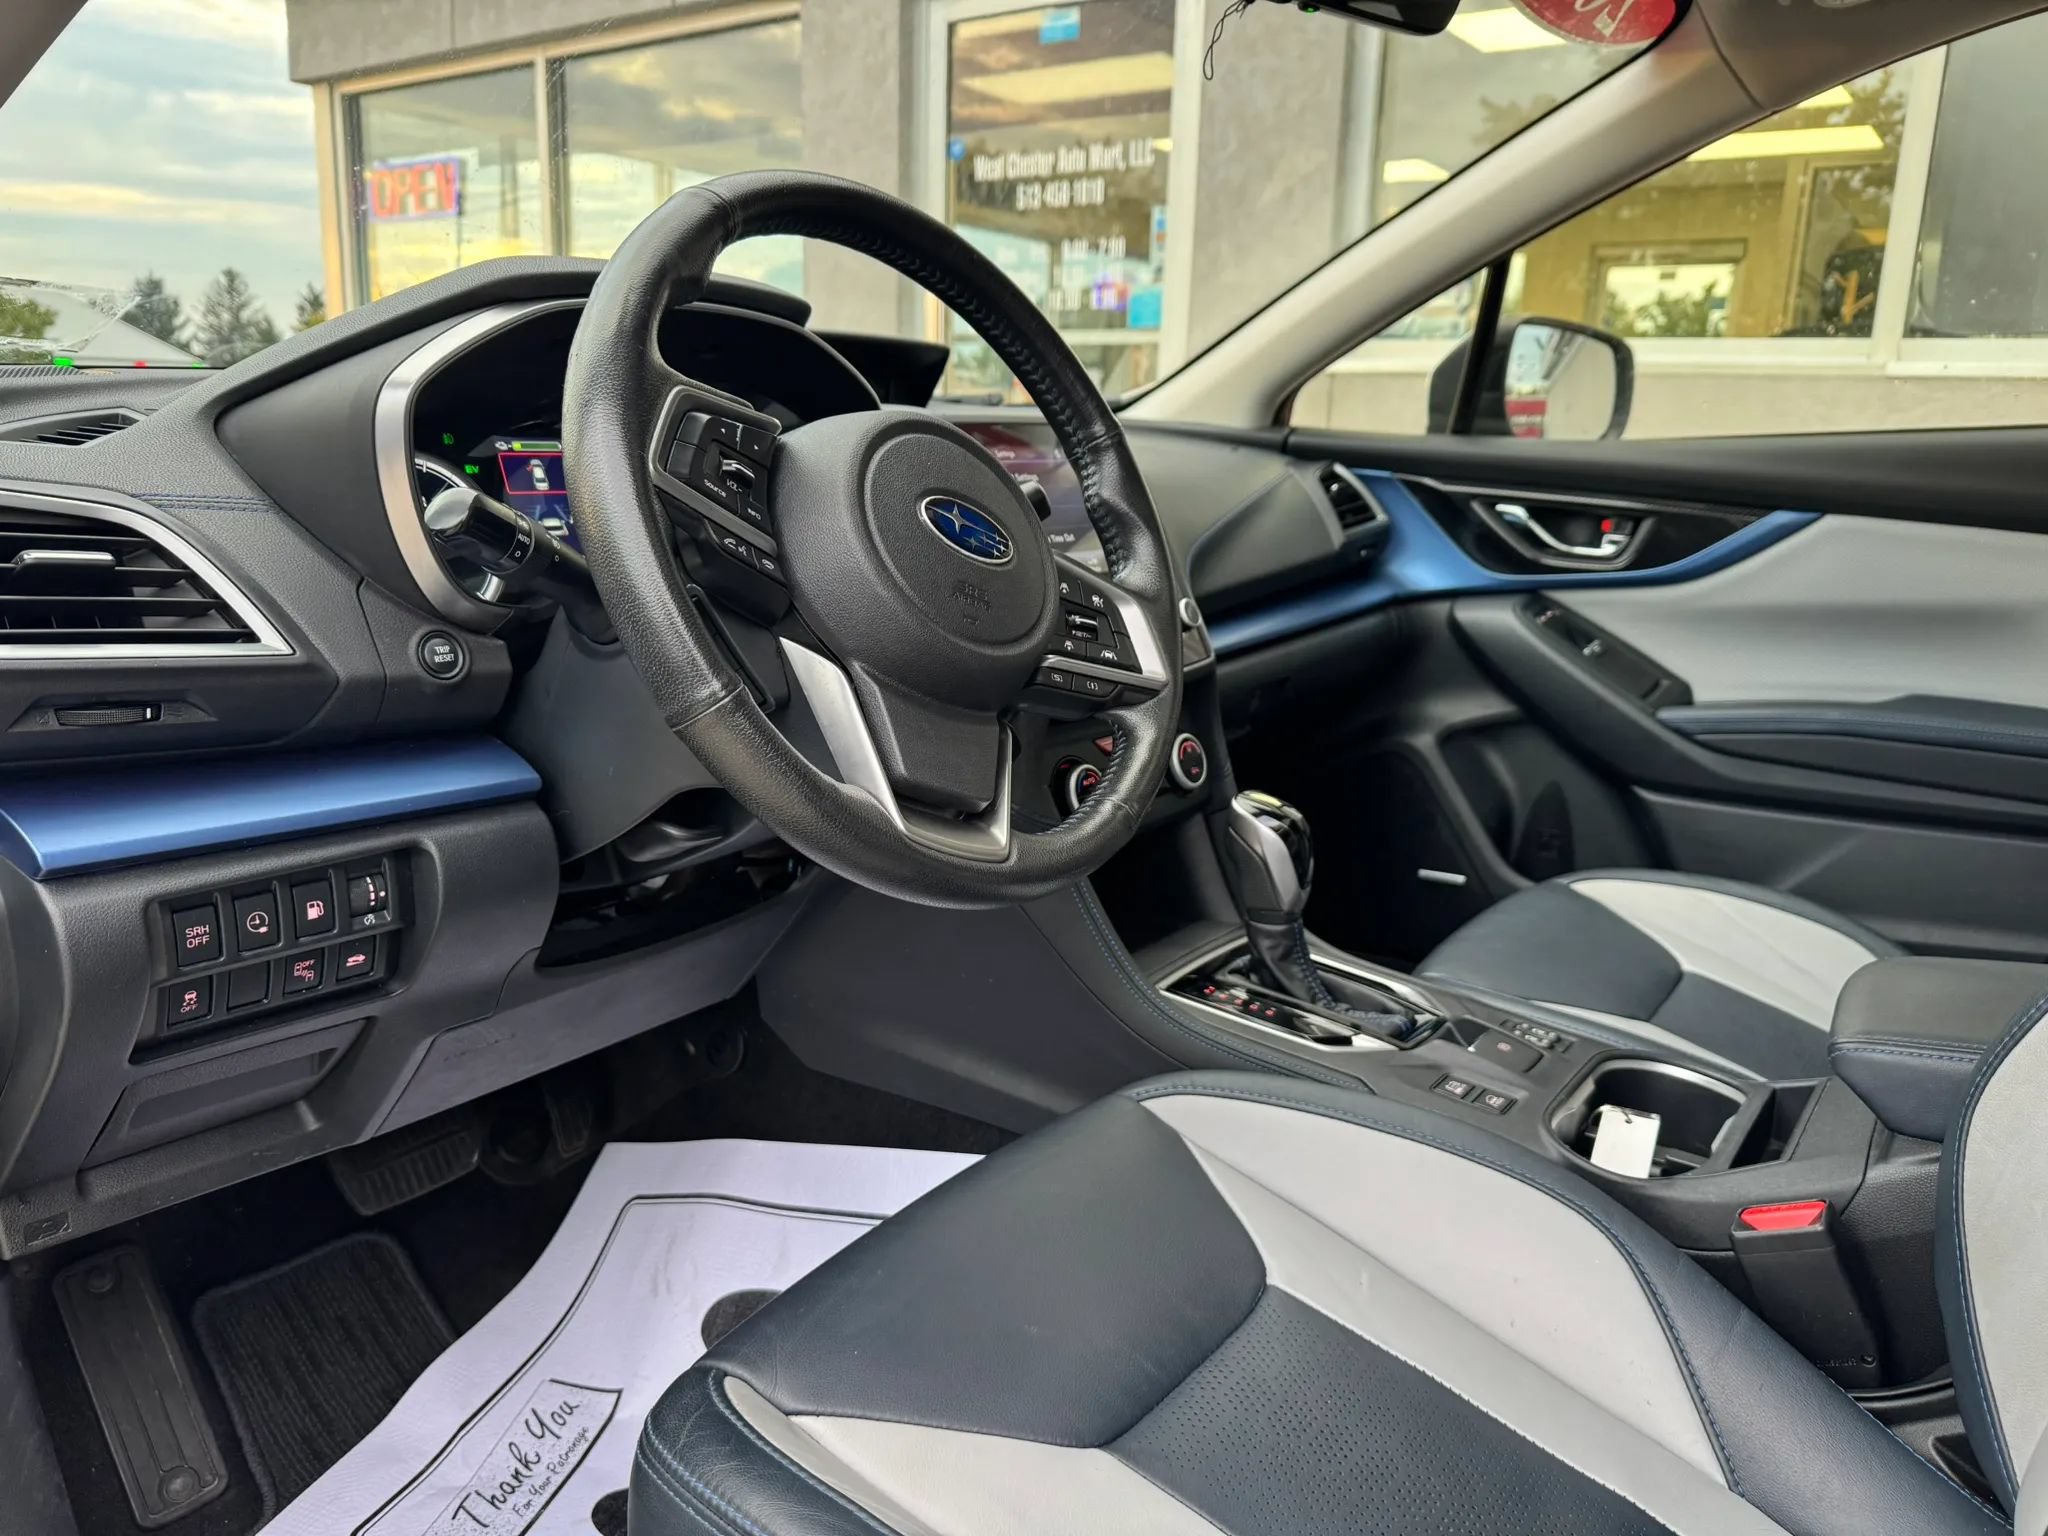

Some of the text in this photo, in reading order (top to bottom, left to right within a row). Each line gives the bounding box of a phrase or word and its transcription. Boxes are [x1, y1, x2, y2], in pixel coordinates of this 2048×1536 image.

[973, 154, 1005, 182] West
[1006, 150, 1056, 178] Chester
[1056, 144, 1088, 174] Auto
[1128, 137, 1155, 167] LLC
[371, 161, 456, 218] OPEN
[464, 465, 479, 474] EV
[518, 533, 531, 545] AUTO
[434, 645, 450, 654] TRIP
[434, 653, 454, 663] RESET
[185, 924, 210, 938] SRH
[186, 935, 210, 949] OFF
[303, 959, 316, 968] OFF
[180, 1003, 199, 1013] OFF
[546, 1426, 590, 1476] Patronage
[451, 1401, 580, 1528] Thank You
